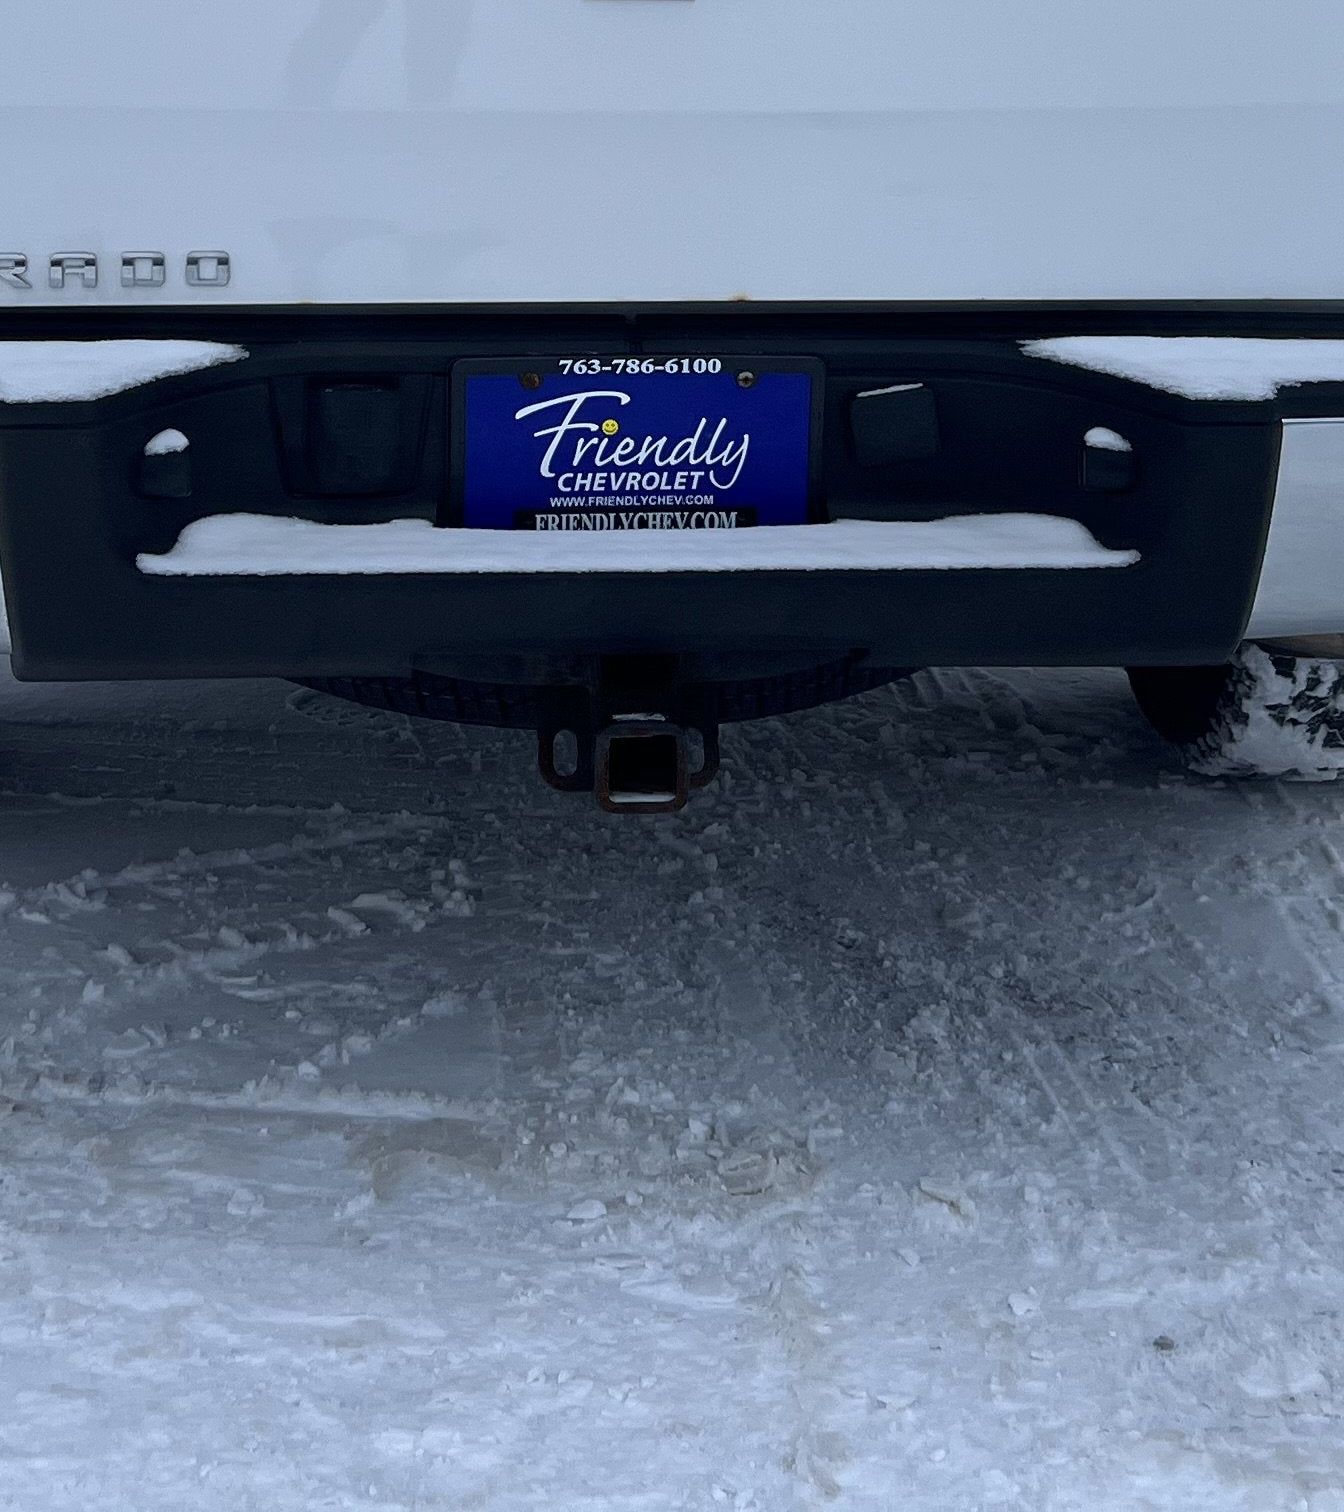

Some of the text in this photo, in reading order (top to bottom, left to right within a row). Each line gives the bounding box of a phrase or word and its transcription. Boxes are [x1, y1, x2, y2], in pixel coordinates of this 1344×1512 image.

[558, 358, 722, 375] 763-786-6100
[515, 390, 749, 489] Friendly
[557, 471, 705, 492] CHEVROLET
[549, 495, 714, 507] WWW.FRIENDLYCHEV.COM
